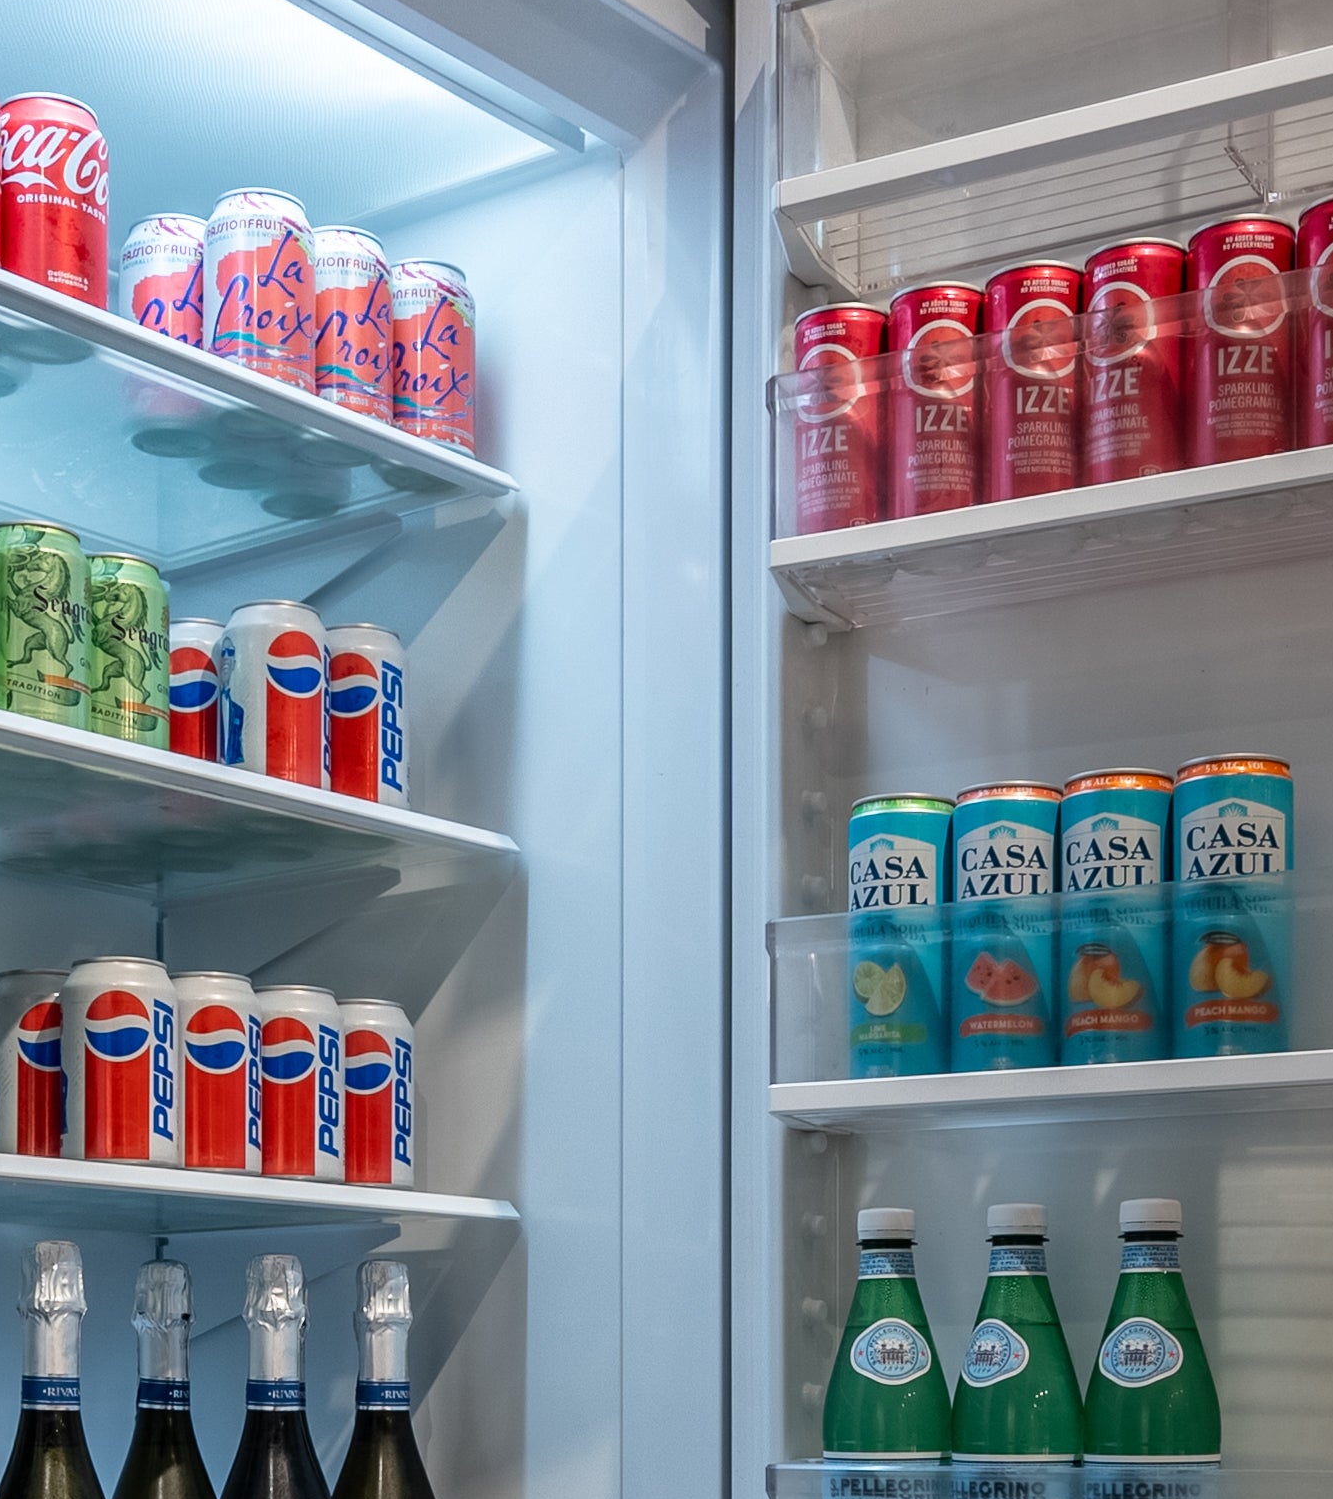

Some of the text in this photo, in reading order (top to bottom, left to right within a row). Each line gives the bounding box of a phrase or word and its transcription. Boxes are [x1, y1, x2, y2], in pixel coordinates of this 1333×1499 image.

[16, 193, 78, 210] ORIGINAL
[257, 229, 305, 299] La
[212, 273, 313, 352] Croix
[354, 272, 392, 339] La
[412, 295, 460, 361] La
[1217, 345, 1275, 377] IZZE
[1016, 385, 1070, 415] IZZE
[1089, 365, 1140, 406] IZZE
[1218, 382, 1275, 397] SPARKLING
[914, 404, 968, 433] IZZE
[801, 424, 849, 461] IZZE
[801, 459, 850, 479] SPARKLING
[6, 678, 61, 700] TRADITION
[381, 659, 403, 793] PEPSI
[1065, 836, 1154, 866] CASA
[1186, 822, 1280, 852] CASA
[850, 855, 928, 885] CASA
[961, 844, 1049, 872] CASA
[1186, 851, 1280, 879] AZUL
[960, 872, 1049, 900] AZUL
[1067, 864, 1154, 893] AZUL
[850, 883, 928, 912] AZUL
[968, 1019, 1034, 1030] WATERMELON
[1071, 1013, 1139, 1027] PEACH MANGO
[1194, 1004, 1268, 1018] PEACH MANGO
[153, 998, 174, 1142] PEPSI
[318, 1023, 340, 1159] PEPSI
[394, 1036, 412, 1167] PEPSI
